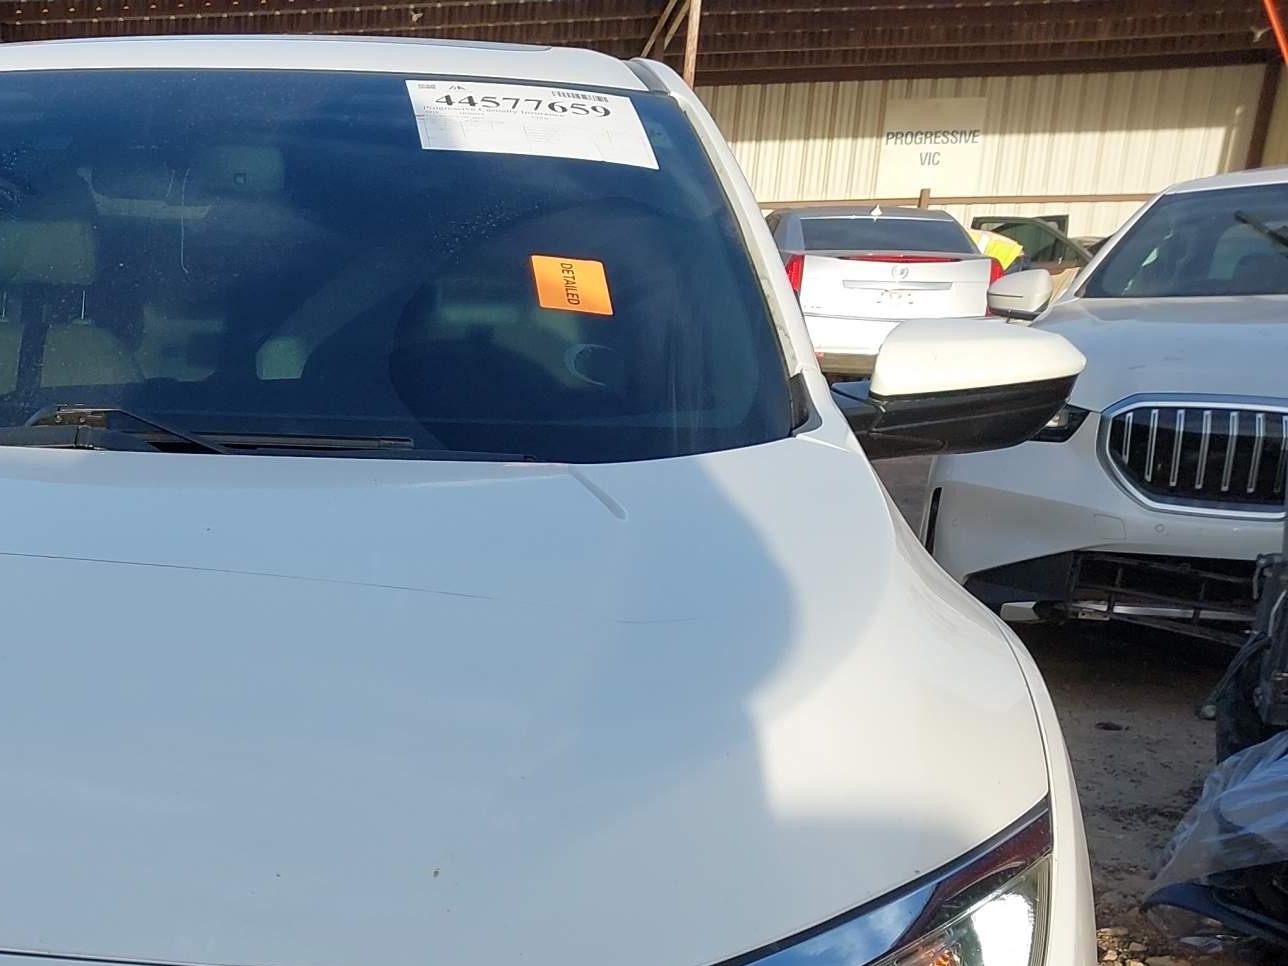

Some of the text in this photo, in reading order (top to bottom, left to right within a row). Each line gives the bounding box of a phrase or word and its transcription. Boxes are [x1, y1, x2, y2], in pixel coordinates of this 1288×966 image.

[434, 94, 611, 118] 44577659
[885, 129, 981, 146] PROGRESSIVE
[919, 151, 941, 166] VIC
[560, 262, 580, 305] DETAILED
